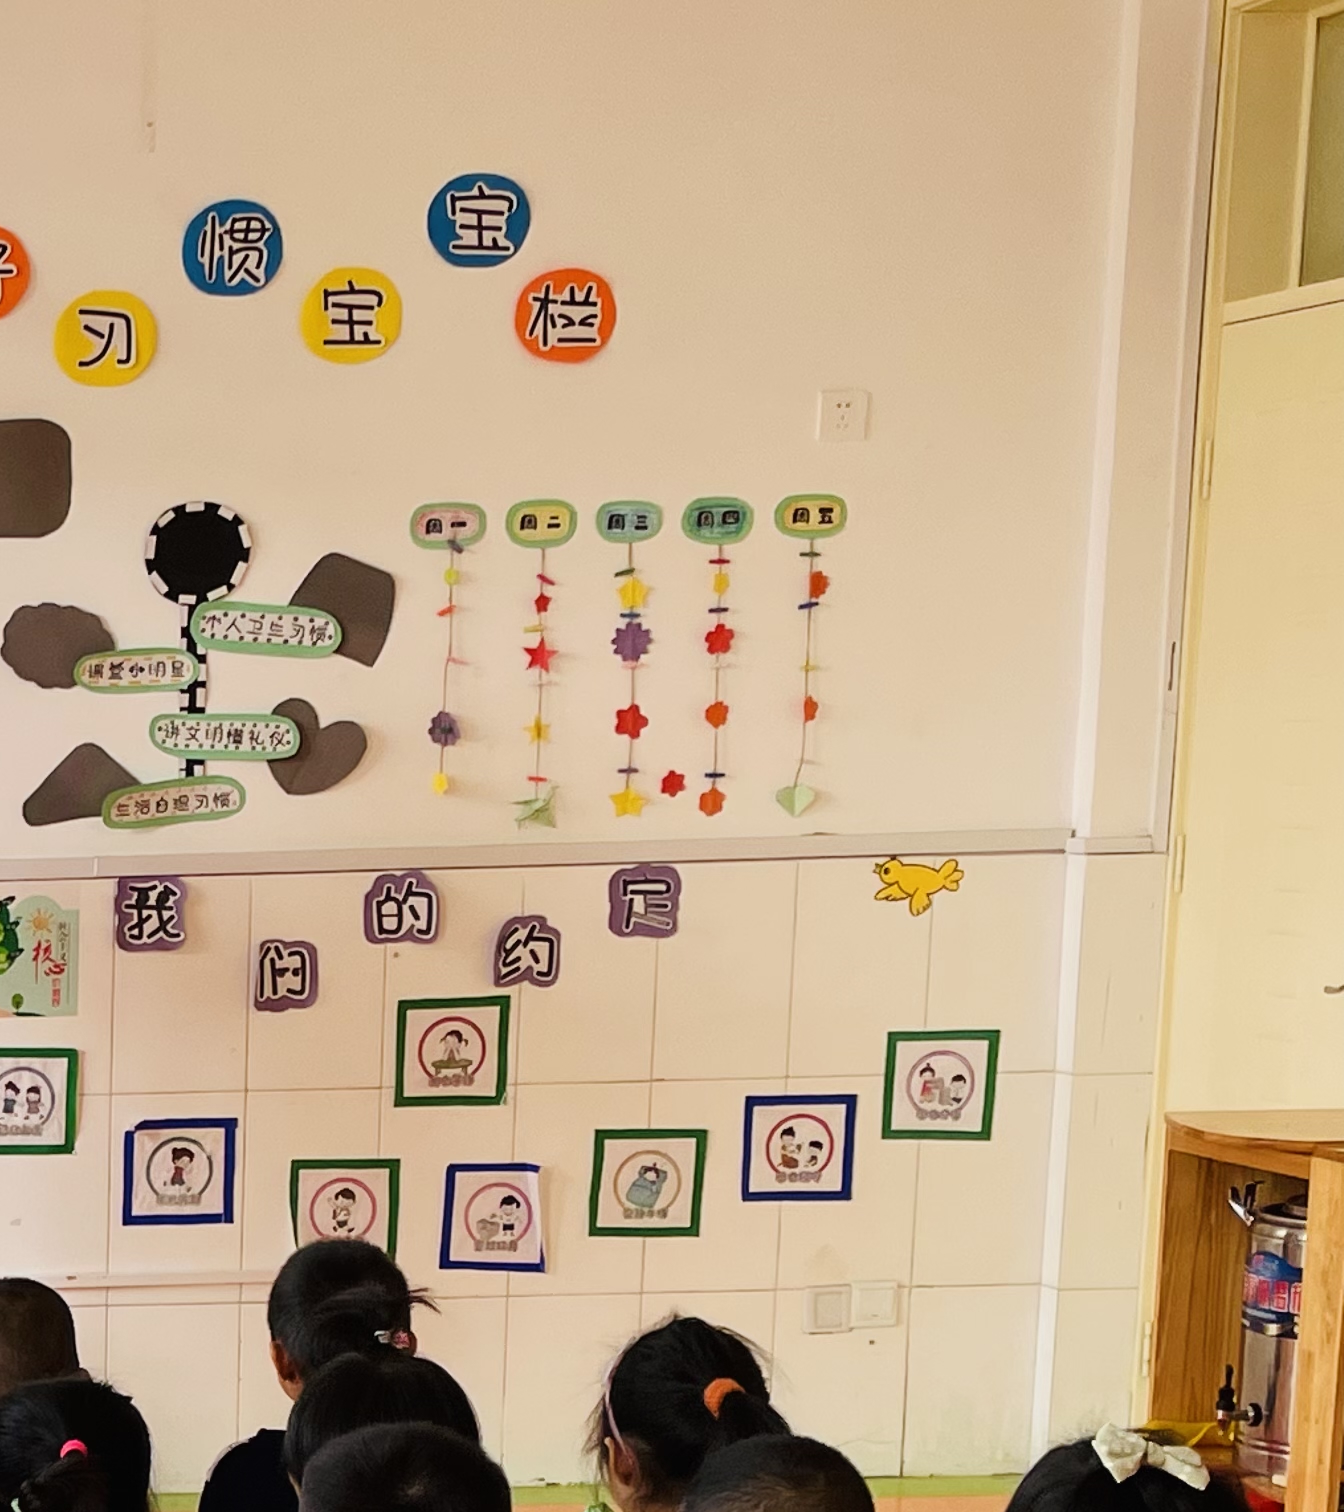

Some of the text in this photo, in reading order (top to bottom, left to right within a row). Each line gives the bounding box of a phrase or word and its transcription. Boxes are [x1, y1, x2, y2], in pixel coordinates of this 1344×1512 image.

[425, 516, 468, 536] 周一
[519, 513, 562, 532] 周二
[607, 512, 649, 532] 周三
[696, 509, 741, 529] 周四
[792, 506, 835, 526] 周五
